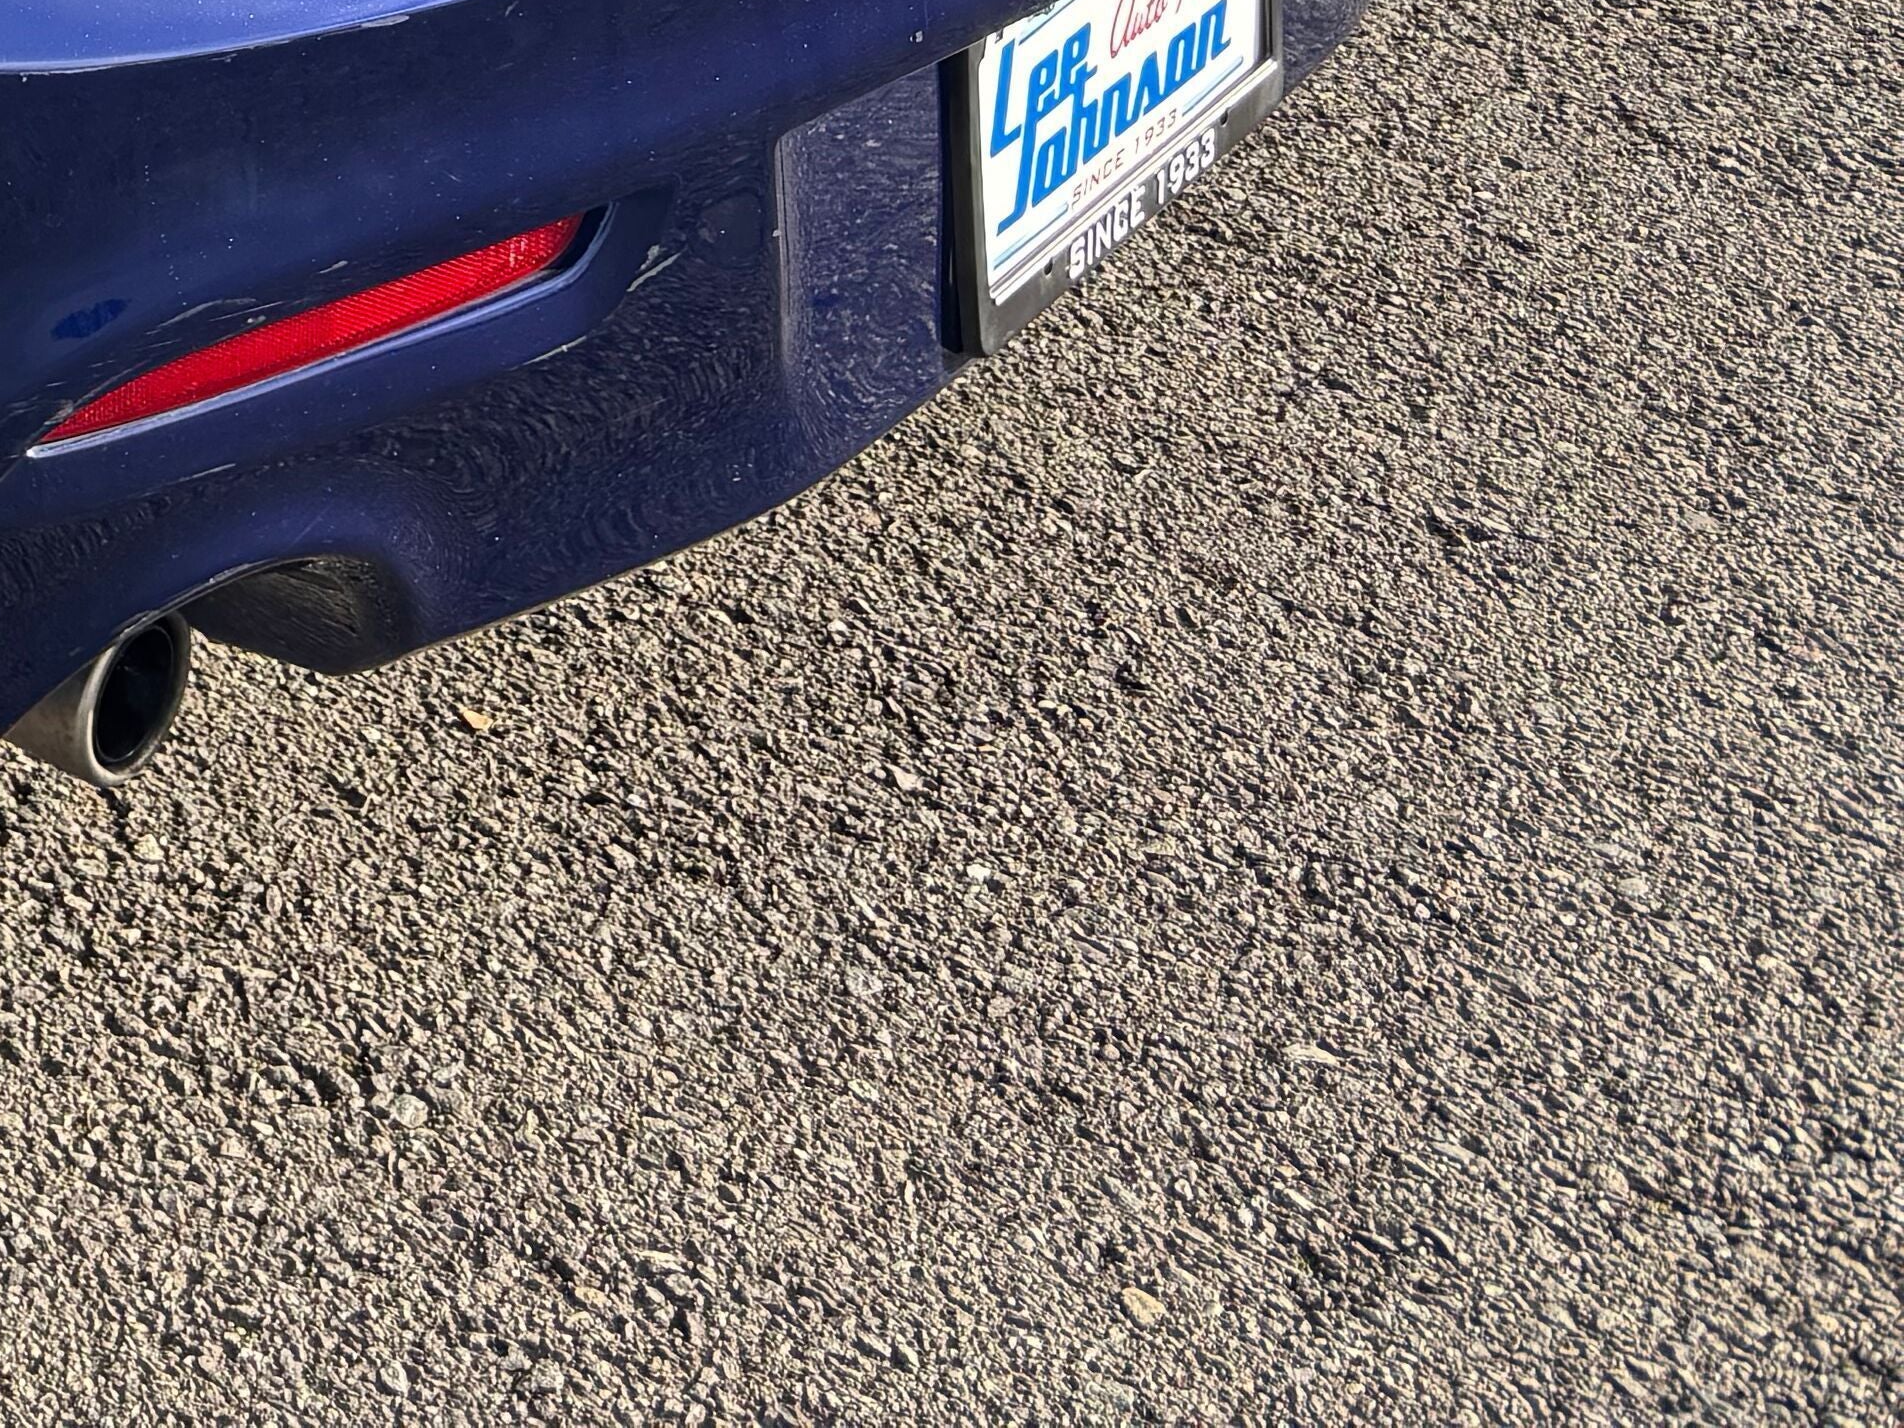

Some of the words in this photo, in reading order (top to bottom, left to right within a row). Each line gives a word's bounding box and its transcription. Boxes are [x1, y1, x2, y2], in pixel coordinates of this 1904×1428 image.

[990, 22, 1097, 158] Lee
[1072, 150, 1124, 202] SINCE
[1135, 107, 1178, 155] 1933
[1068, 190, 1145, 279] SINCE
[1155, 127, 1216, 206] 1933
